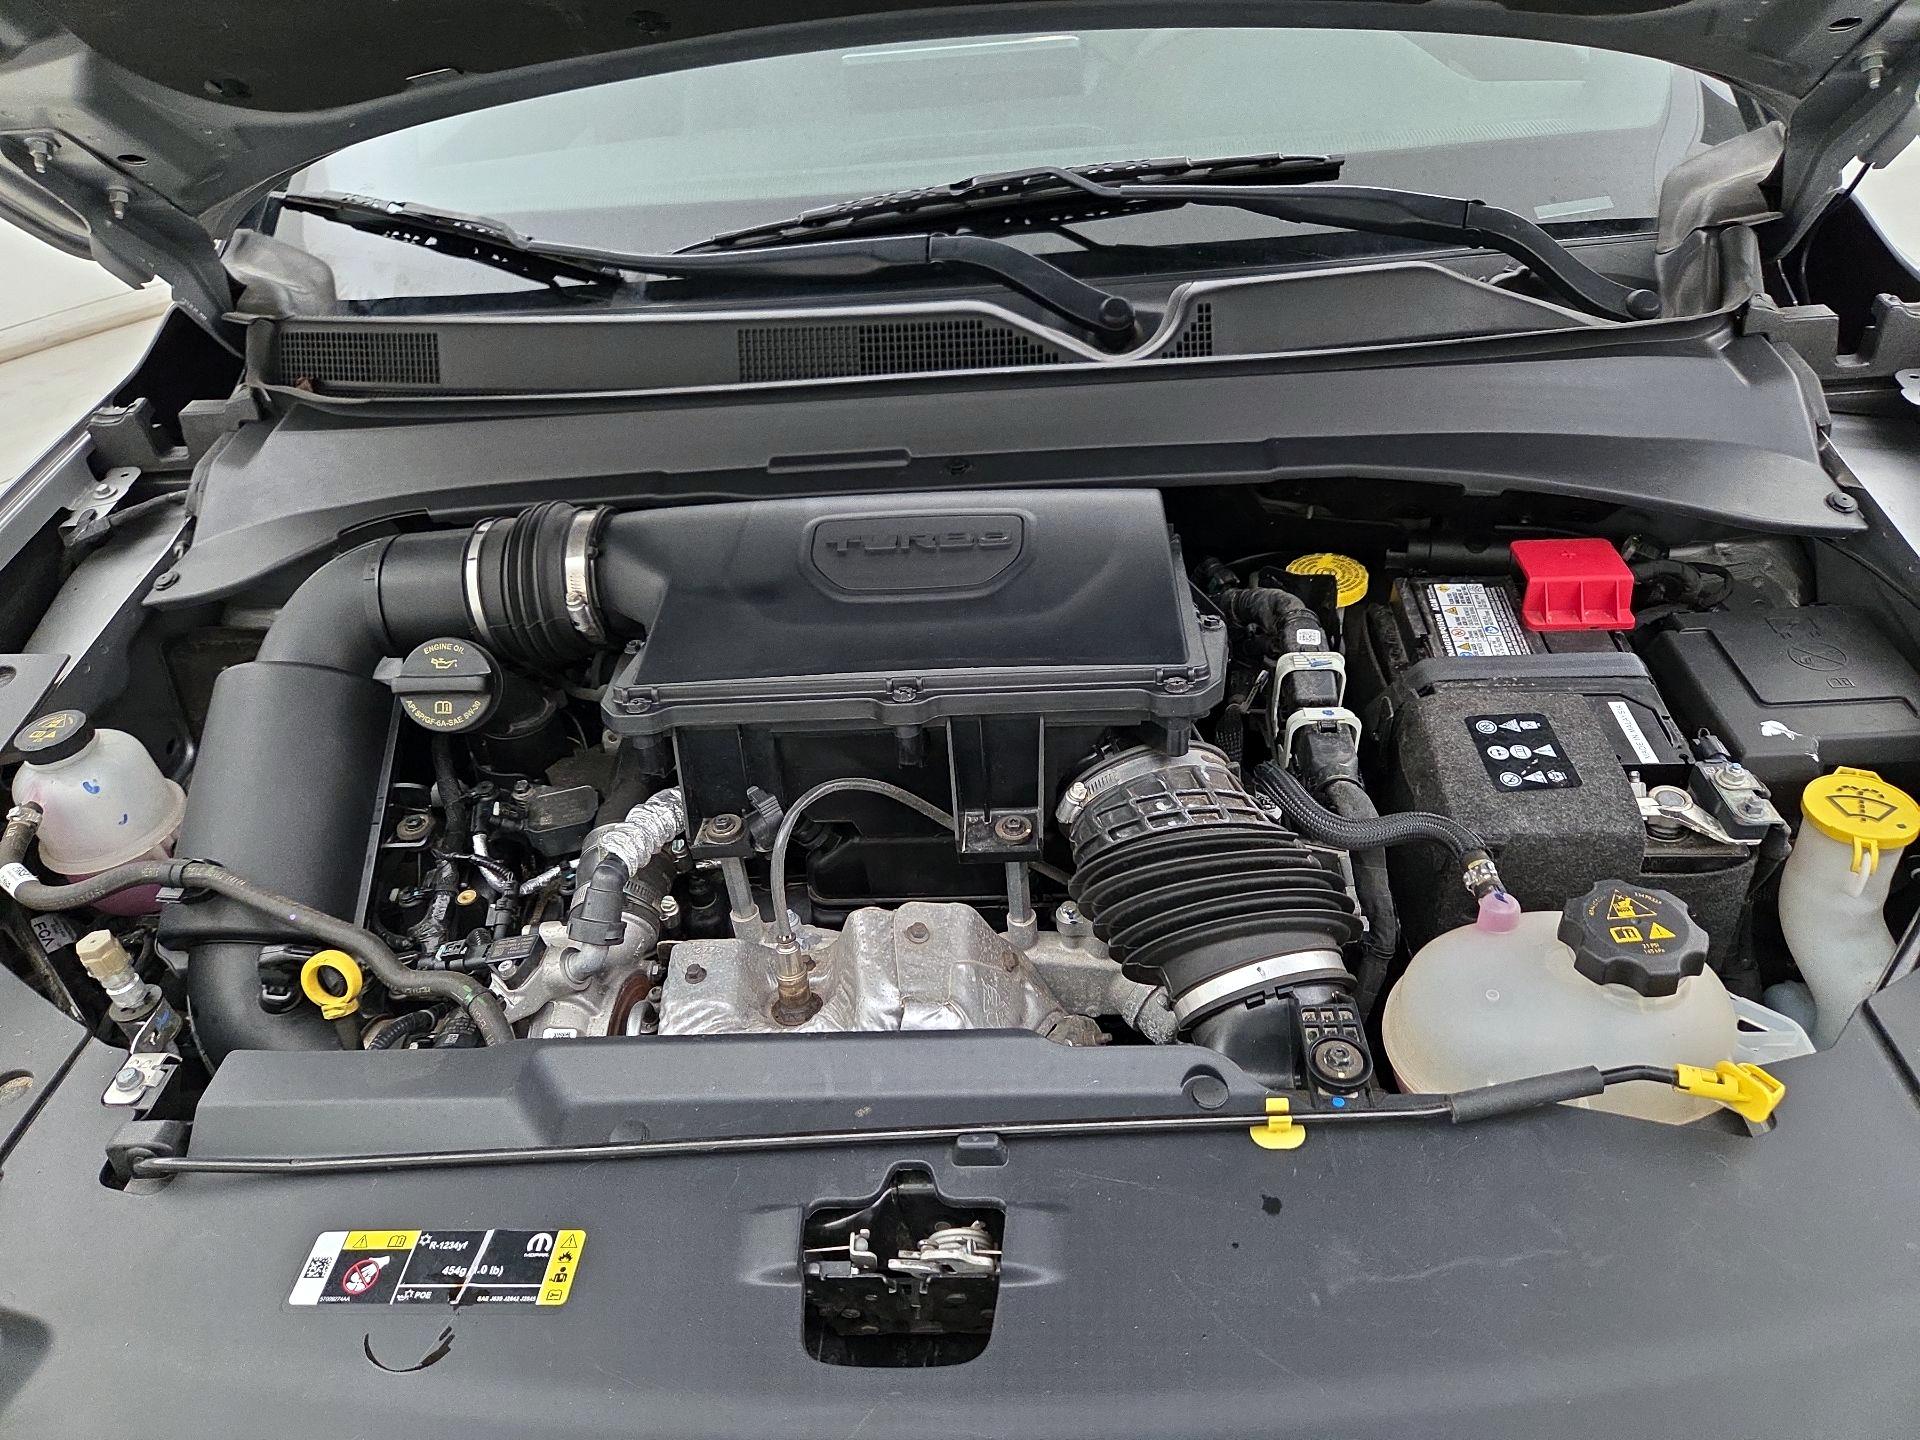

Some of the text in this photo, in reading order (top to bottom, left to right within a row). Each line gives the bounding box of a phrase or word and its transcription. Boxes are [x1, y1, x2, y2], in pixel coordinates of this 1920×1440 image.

[825, 532, 1013, 556] TURBO
[423, 643, 465, 655] ENGINE OIL
[406, 700, 416, 713] API
[463, 700, 481, 719] 5W-30
[34, 922, 55, 947] FCA
[429, 1240, 468, 1252] R-1234yf
[442, 1266, 468, 1277] 454g
[414, 1291, 432, 1299] POE
